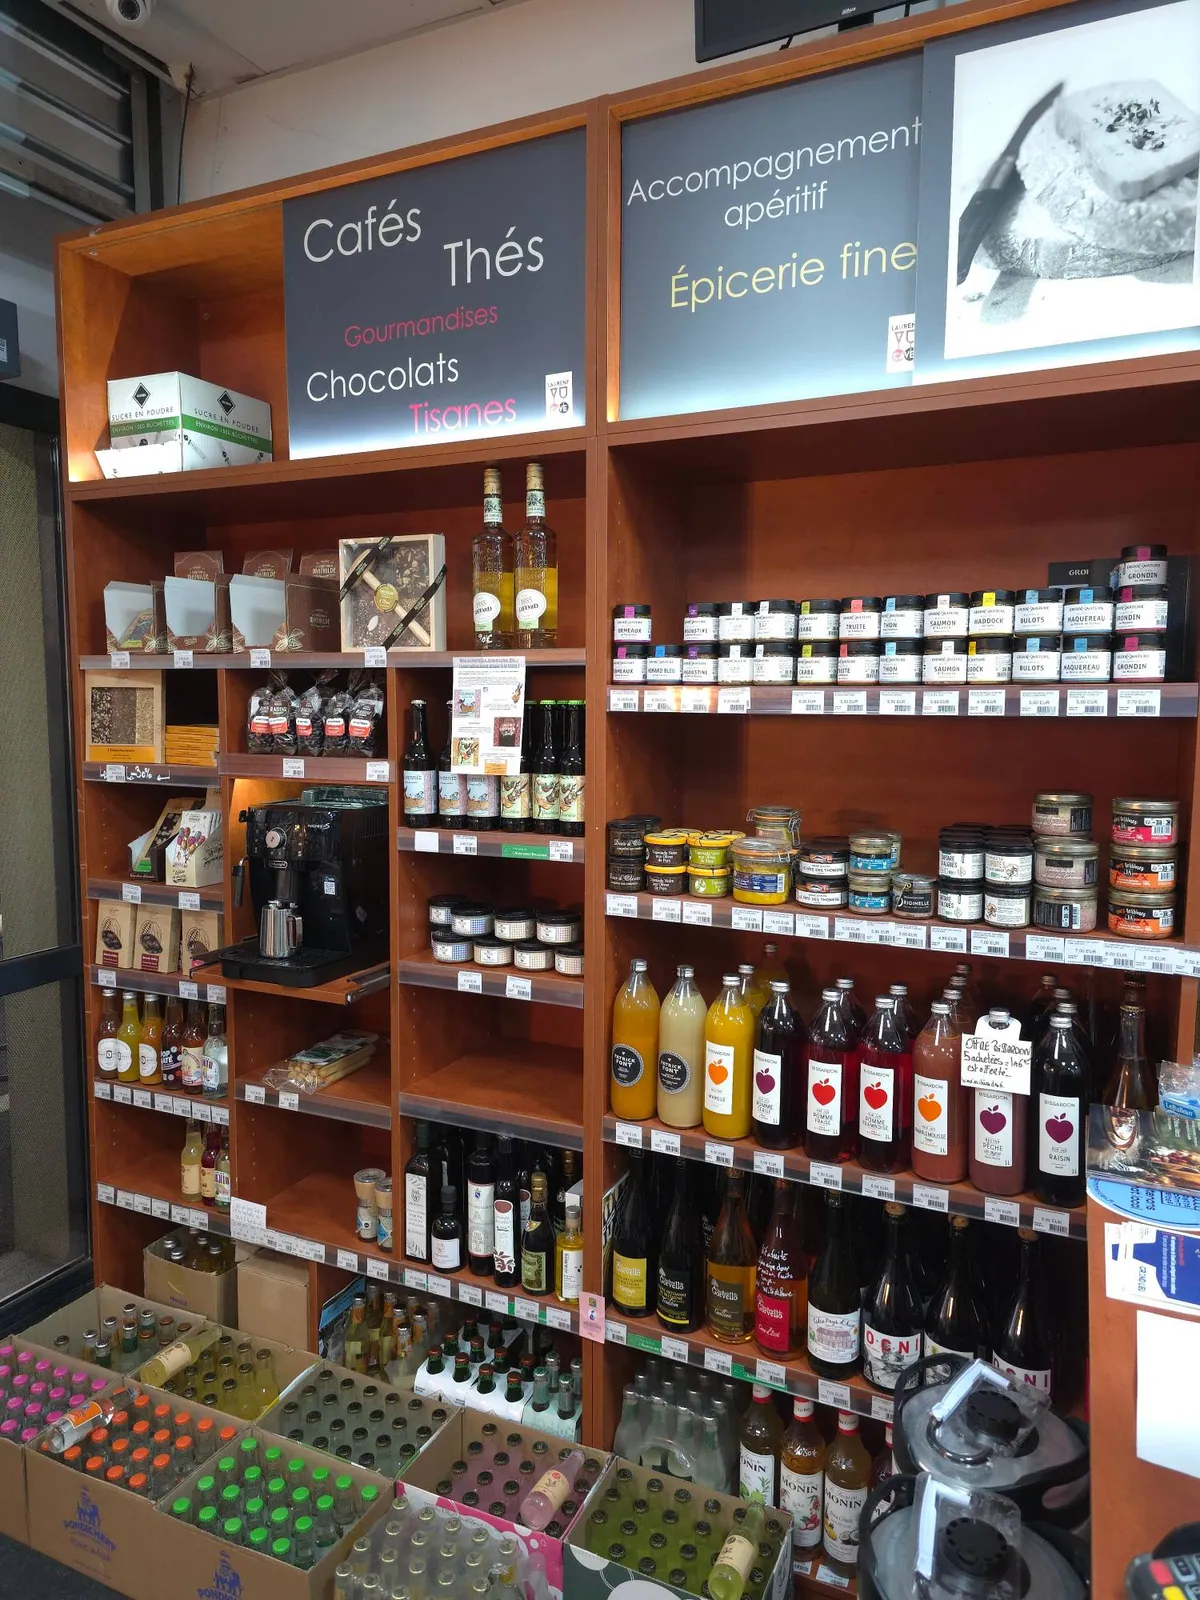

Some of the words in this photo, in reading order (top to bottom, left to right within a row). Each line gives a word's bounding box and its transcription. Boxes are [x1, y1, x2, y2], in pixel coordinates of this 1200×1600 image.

[627, 116, 922, 205] Accompagnement
[724, 180, 828, 230] apéritif
[303, 199, 422, 262] Cafés
[443, 226, 544, 286] Thés
[671, 253, 825, 313] Épicerie
[840, 241, 918, 279] fine
[344, 305, 498, 347] Gourmandises
[306, 353, 459, 402] Chocolats
[111, 412, 133, 421] SUCRE
[146, 406, 174, 416] POUDRE
[194, 408, 217, 421] SUCRE
[220, 416, 229, 424] EN
[232, 421, 260, 434] POUDRE
[409, 397, 517, 434] Tisanes
[195, 421, 220, 432] ENVIRON
[614, 1054, 636, 1063] PATRICK
[616, 1059, 632, 1068] FONT
[661, 1060, 681, 1070] PATRICK
[662, 1066, 679, 1074] FONT
[978, 1091, 1008, 1101] BISSARDON
[1044, 1100, 1075, 1108] BISSARDON
[813, 1112, 833, 1121] POMME
[864, 1116, 885, 1126] POMME
[1049, 1153, 1071, 1162] RAISIN
[781, 1477, 818, 1494] MONIN
[826, 1487, 862, 1508] MONIN
